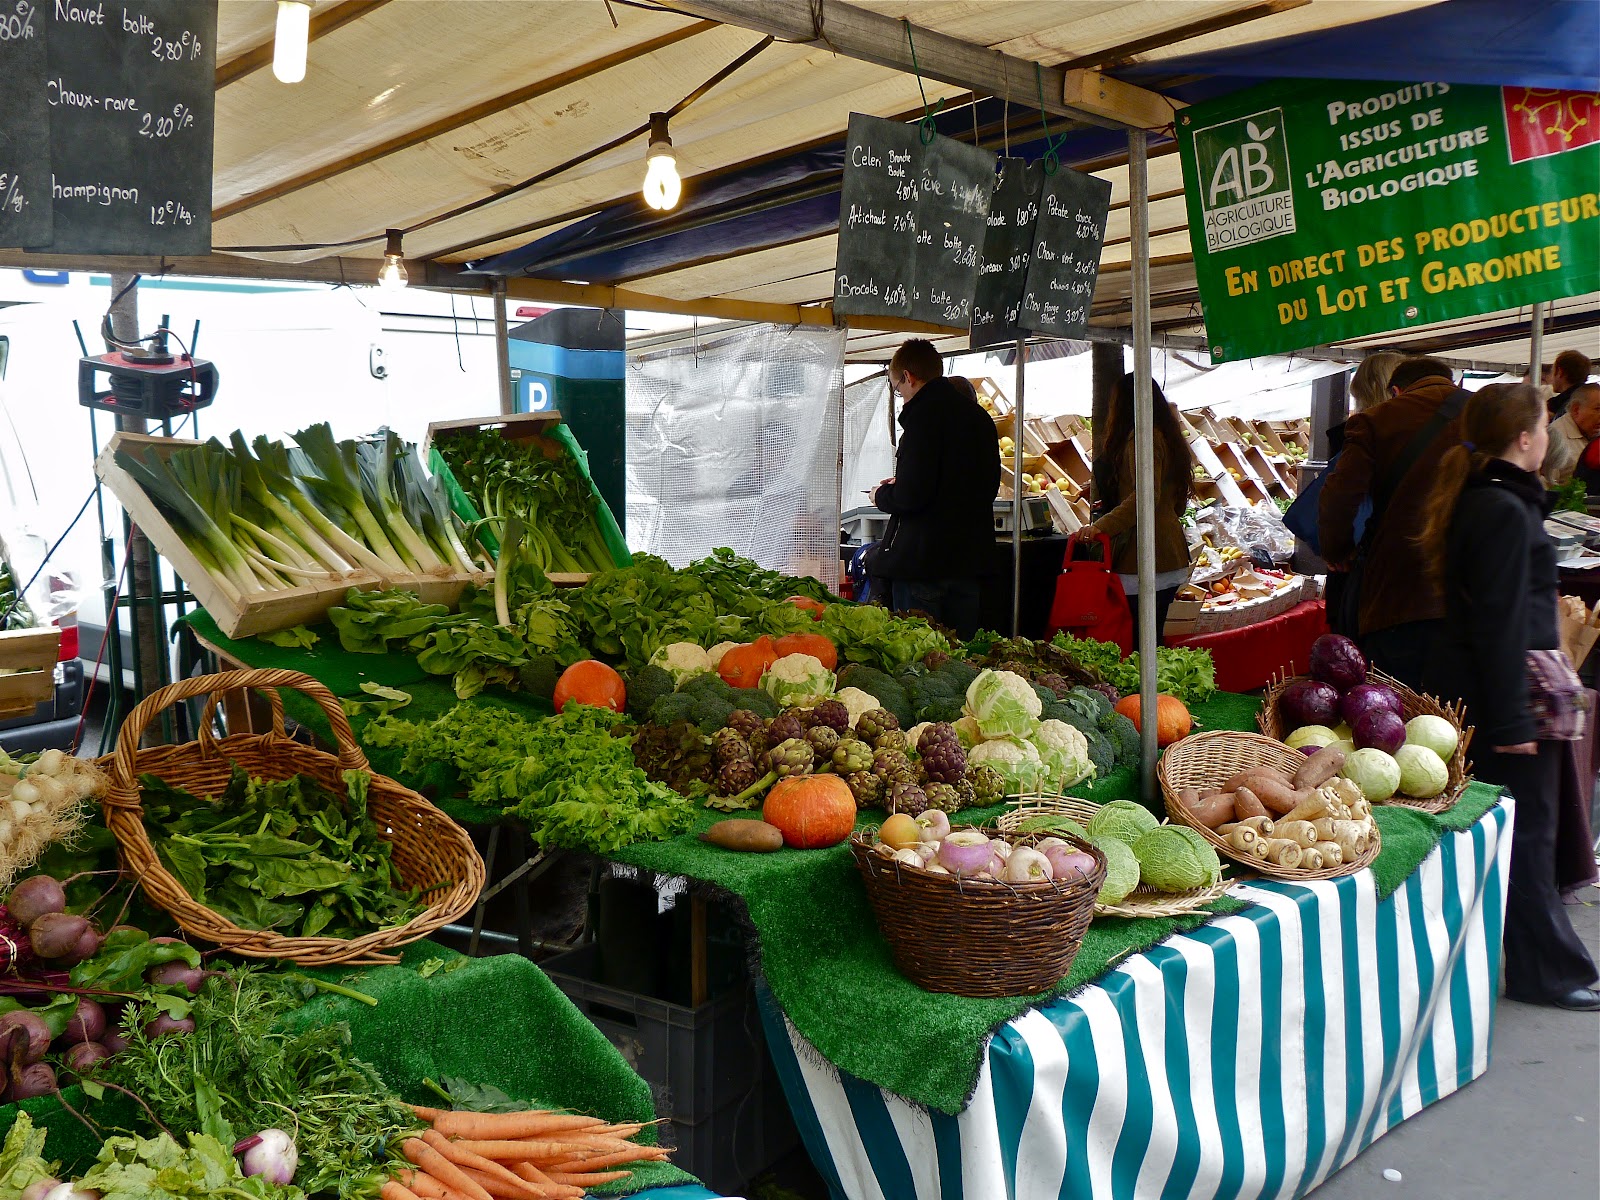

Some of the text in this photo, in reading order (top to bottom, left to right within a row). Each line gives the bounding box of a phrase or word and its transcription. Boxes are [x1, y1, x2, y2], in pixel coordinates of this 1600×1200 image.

[55, 0, 155, 35] Navet botte
[1339, 107, 1444, 151] ISSUS DE
[1209, 142, 1274, 206] AB
[1305, 125, 1490, 189] L'AGRICULTURE
[1320, 159, 1479, 211] BIOLOGIQUE
[847, 203, 887, 230] Artichaut
[1206, 195, 1292, 229] AGRICULTURE
[943, 232, 963, 250] botte
[1208, 213, 1293, 247] BIOLOGIQUE
[1225, 192, 1600, 297] EN DIRECT DES PRODUCTEUR
[837, 274, 879, 298] Brocolis
[930, 288, 953, 304] botte
[1277, 245, 1562, 325] DU LOT ET GARONNE
[528, 382, 547, 412] P
